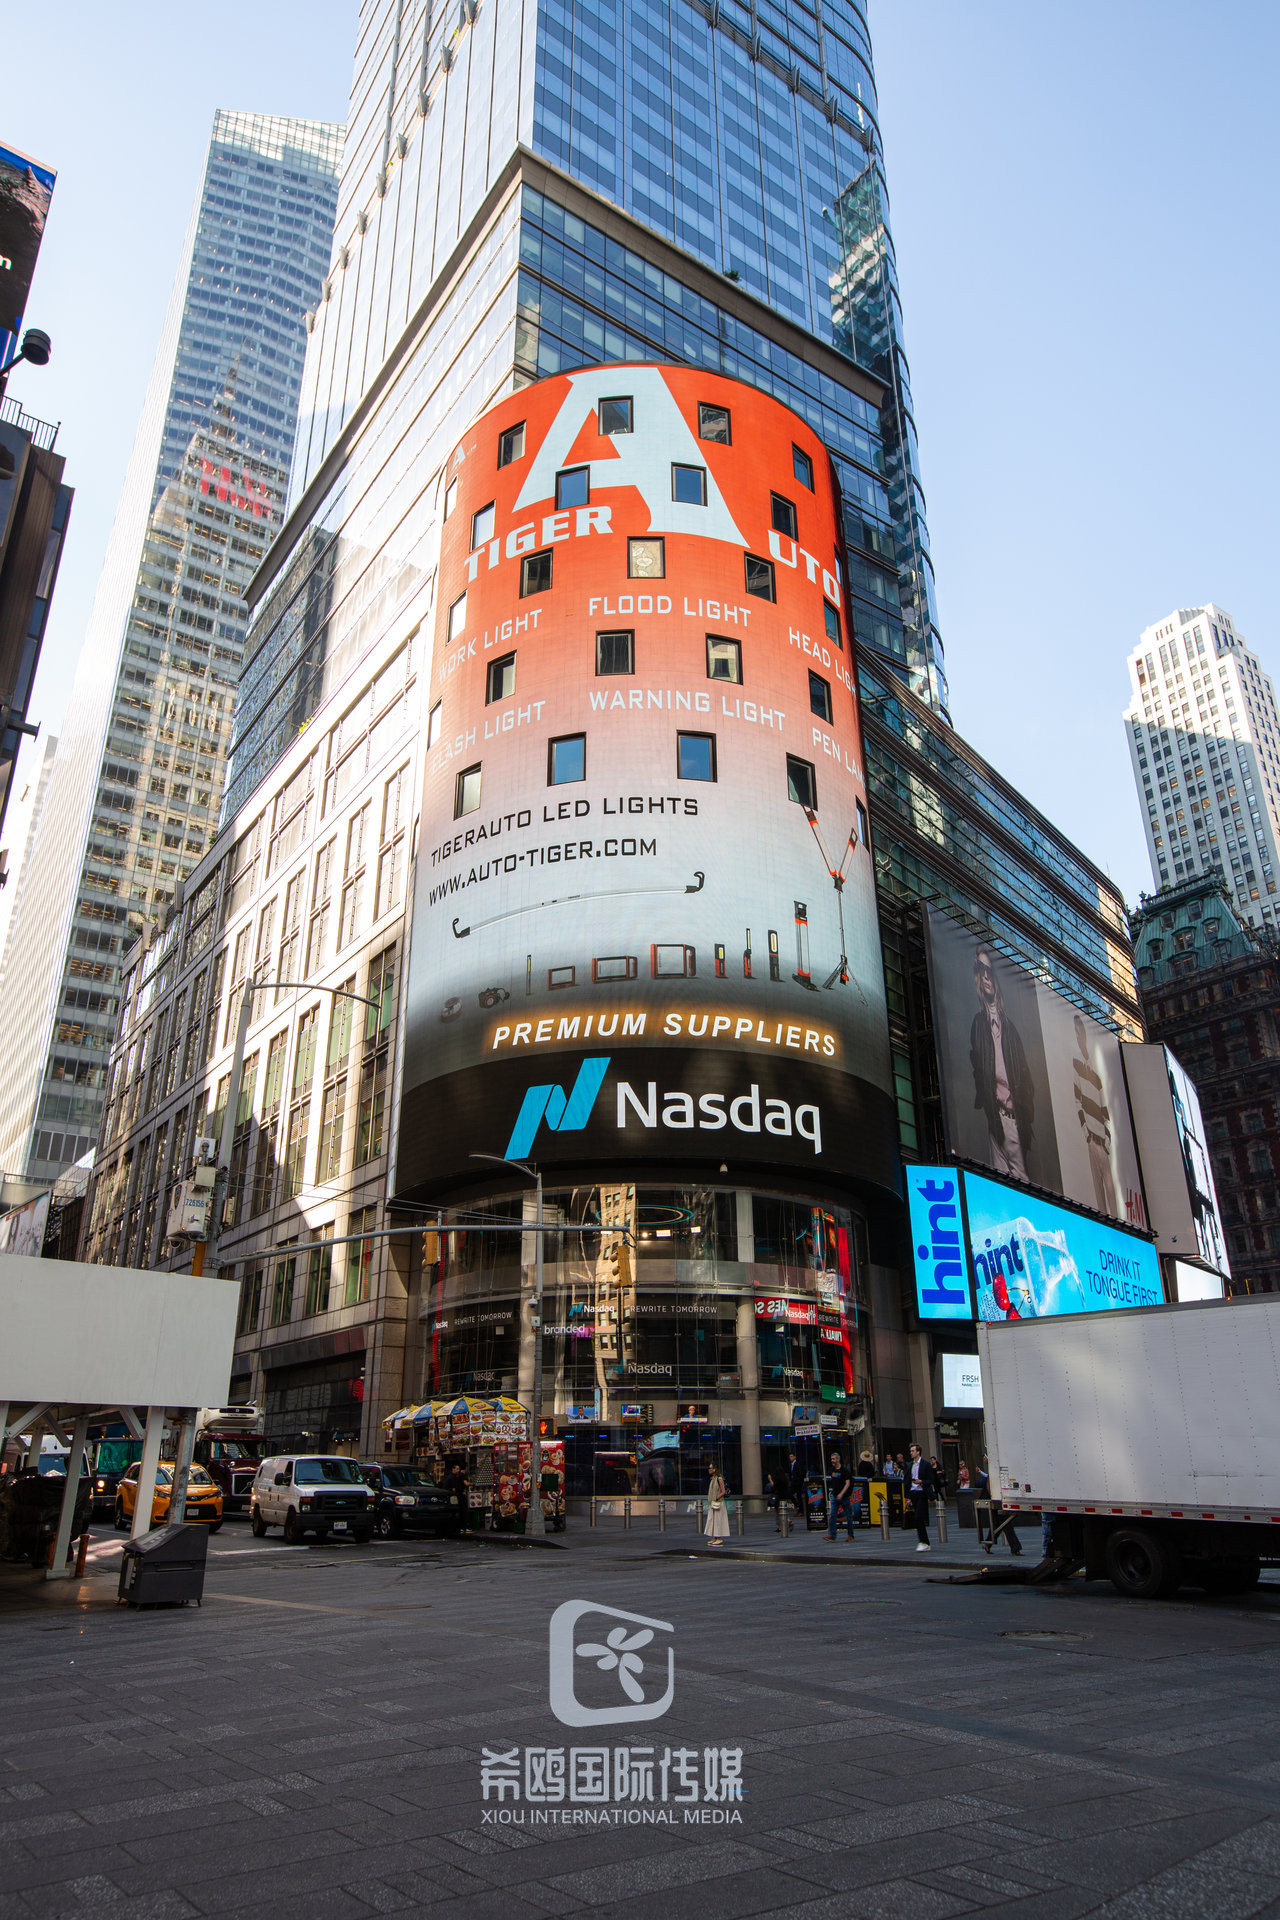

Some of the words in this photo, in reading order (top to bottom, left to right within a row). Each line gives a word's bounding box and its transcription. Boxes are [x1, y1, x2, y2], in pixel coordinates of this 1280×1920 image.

[464, 505, 613, 583] TIGER
[767, 529, 841, 608] UTO
[589, 595, 672, 616] FLOOD
[684, 597, 751, 627] LIGHT
[438, 637, 477, 682] WORK
[484, 608, 542, 649] LIGHT
[788, 626, 831, 668] HEAD
[835, 659, 857, 700] LIGH
[589, 689, 710, 712] WARNING
[722, 695, 786, 731] LIGHT
[431, 726, 476, 774] FLASH
[484, 700, 546, 740] LIGHT
[812, 727, 841, 763] PEN
[845, 751, 866, 791] LAM
[431, 809, 531, 867] TIGERAUTO
[543, 799, 590, 823] LED
[603, 796, 699, 816] LIGHTS
[429, 838, 657, 906] WWW.AUTO-TIGER.COM
[492, 1013, 647, 1050] PREMIUM
[663, 1013, 835, 1056] SUPPLIERS
[616, 1081, 823, 1154] Nasdaq
[916, 1178, 966, 1305] hint
[971, 1232, 1024, 1289] hint
[1099, 1249, 1133, 1279] DRINK
[1132, 1261, 1141, 1282] IT
[583, 1304, 615, 1314] Nasdaq
[630, 1305, 667, 1313] REWRITE
[671, 1305, 717, 1314] TOMORROW
[1085, 1270, 1132, 1303] TONGUE
[1132, 1285, 1158, 1306] FIRST
[477, 1311, 512, 1323] TOMORROW
[785, 1309, 809, 1321] Nasdaq
[628, 1363, 672, 1377] Nasdaq
[961, 1374, 980, 1383] FRSH
